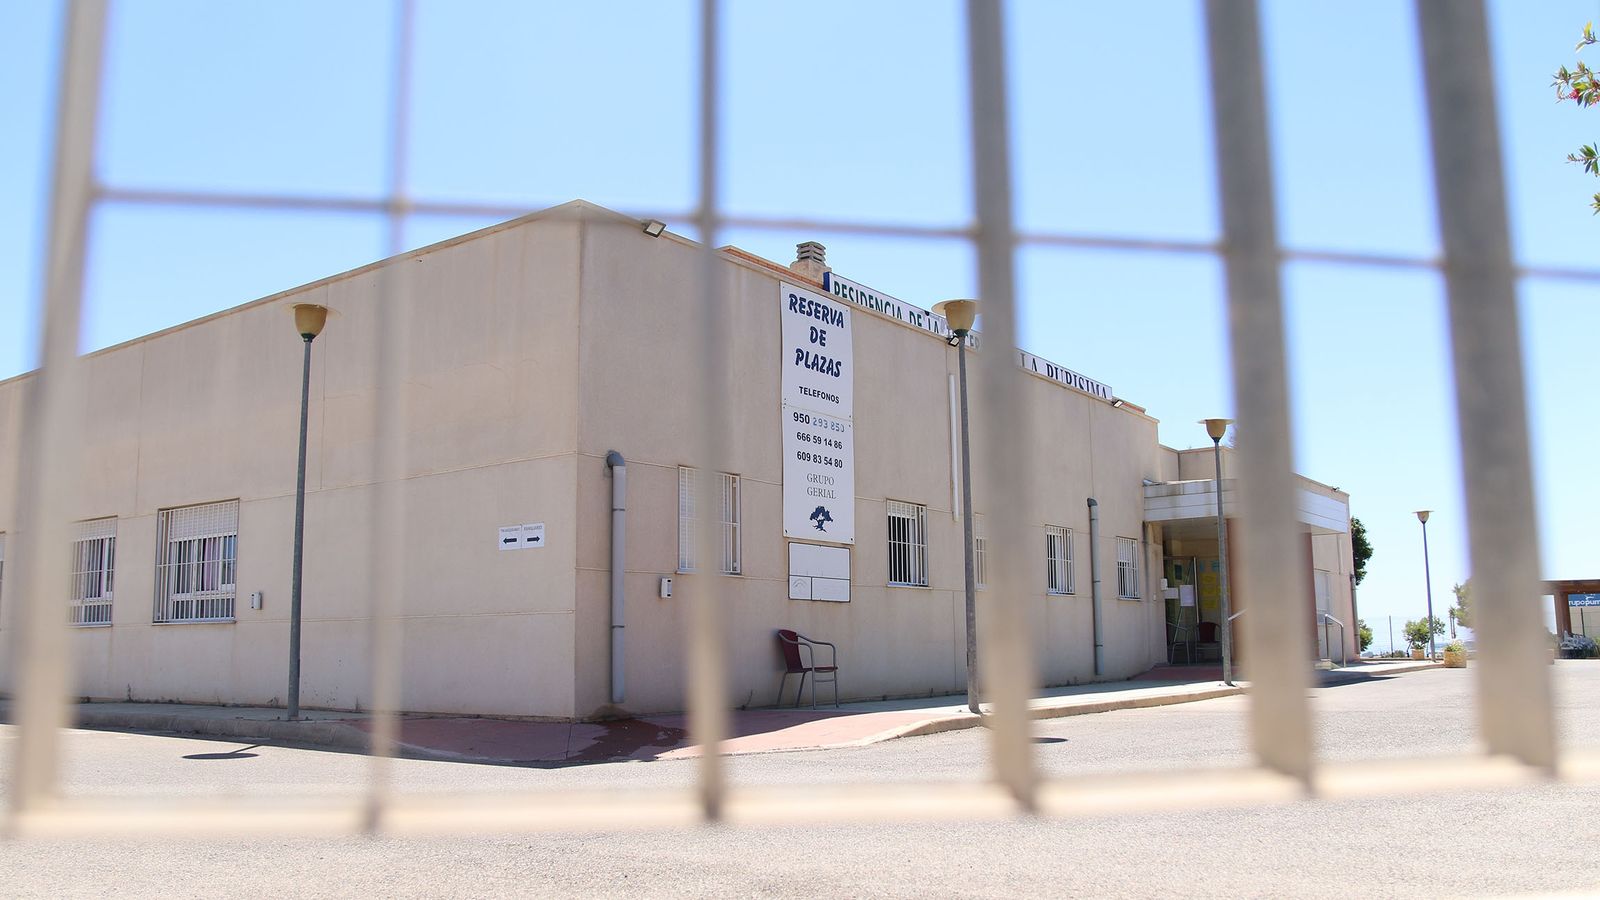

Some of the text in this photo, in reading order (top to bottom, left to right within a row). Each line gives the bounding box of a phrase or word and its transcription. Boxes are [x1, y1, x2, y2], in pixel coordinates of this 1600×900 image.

[788, 293, 844, 328] RESERVA
[909, 310, 922, 328] DE
[809, 326, 827, 347] DE
[795, 348, 842, 378] PLAZAS
[798, 386, 840, 404] TELEFONOS
[793, 411, 810, 424] 950
[812, 417, 829, 429] 293
[796, 431, 843, 449] 666 59 14 86
[796, 451, 843, 468] 609 83 54 80
[806, 473, 835, 486] GRUPO
[806, 487, 837, 500] GERIAL
